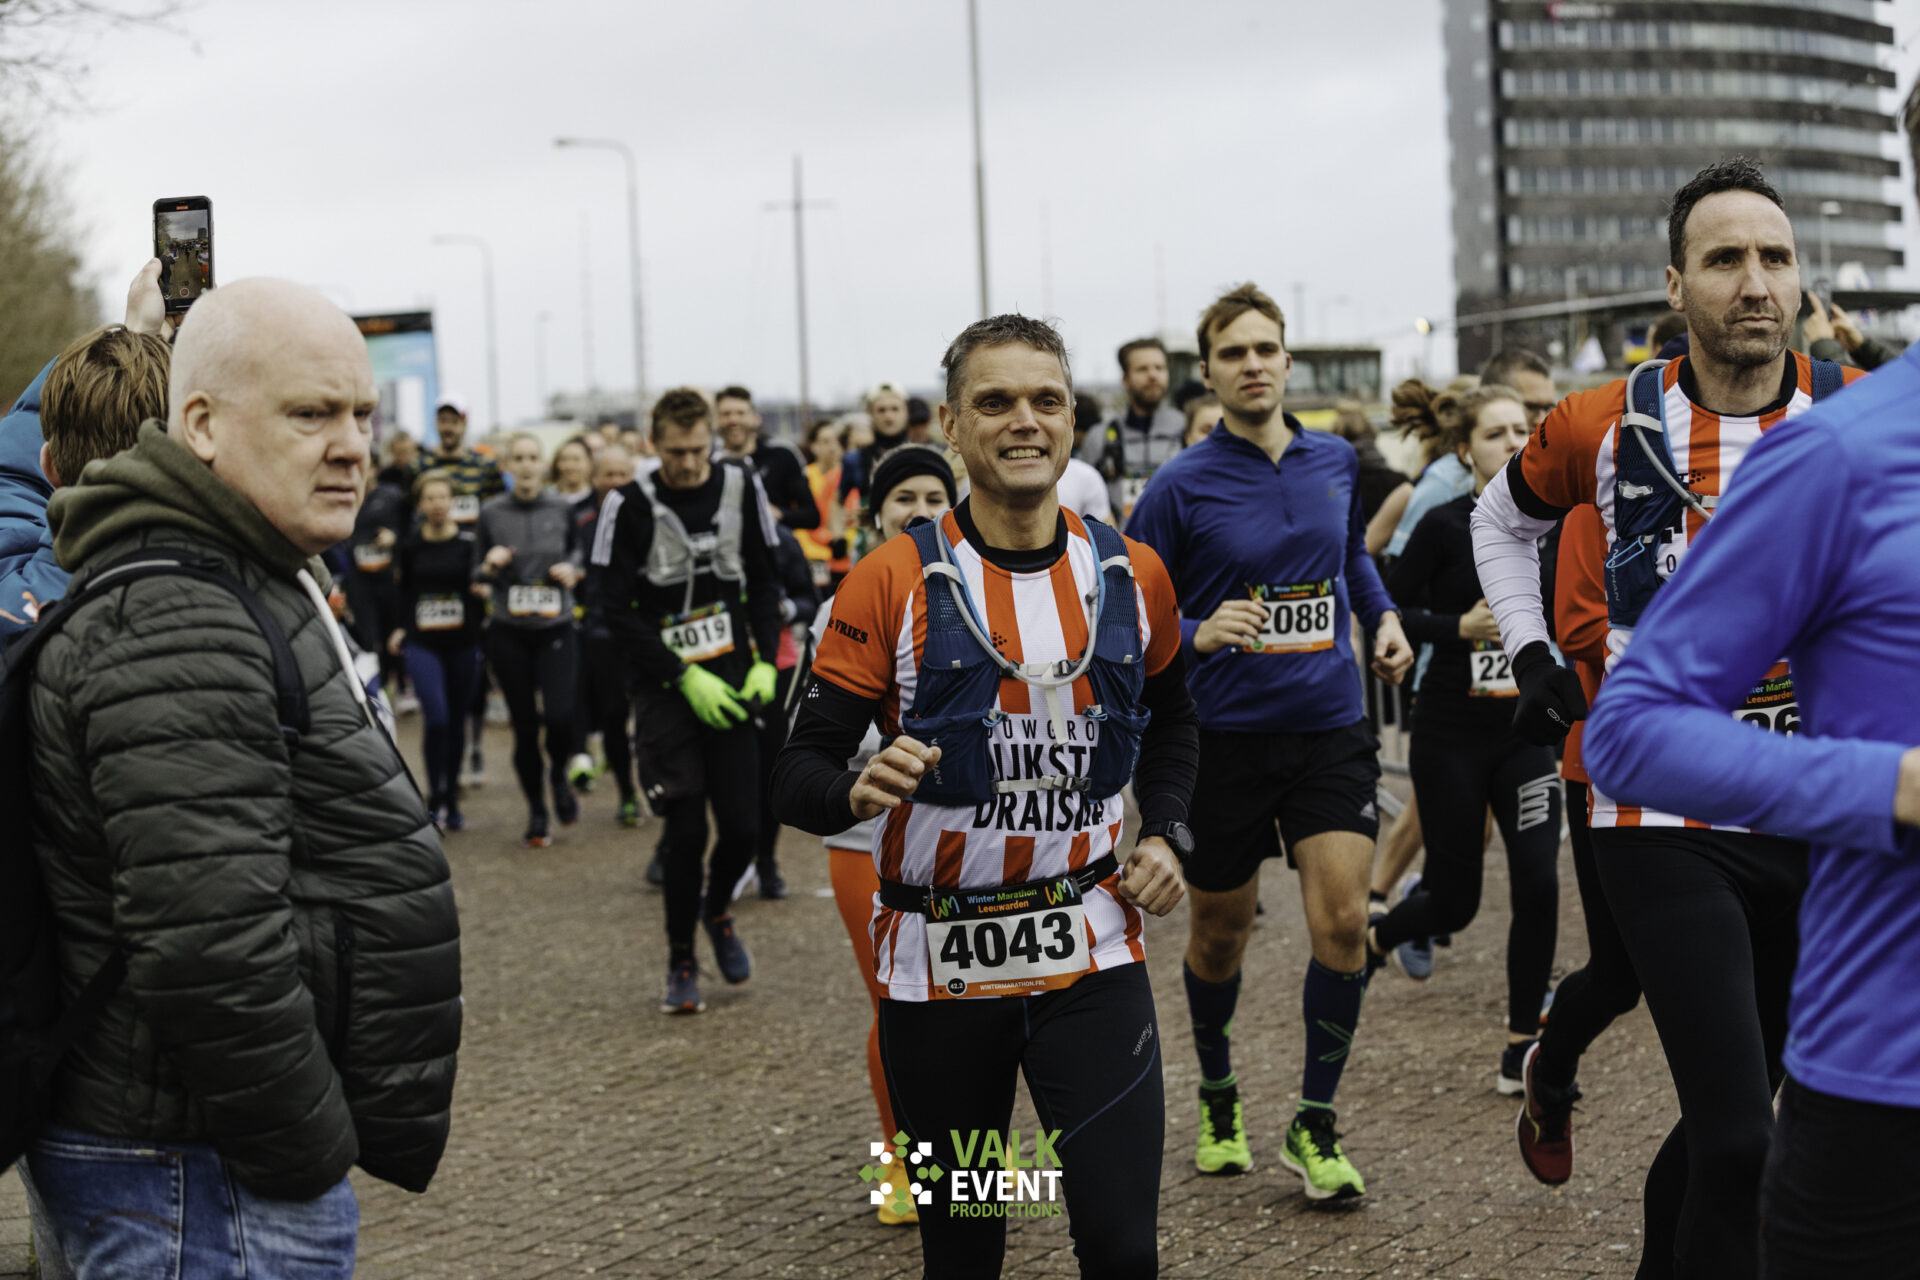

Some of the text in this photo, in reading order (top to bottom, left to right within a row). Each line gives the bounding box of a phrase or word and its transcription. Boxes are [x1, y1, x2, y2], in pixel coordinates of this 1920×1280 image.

[671, 618, 726, 648] 4019
[835, 618, 869, 645] VRIES
[1479, 654, 1510, 682] 22
[967, 888, 1037, 904] Winter Marathon
[977, 899, 1030, 914] Leeuwarden
[940, 911, 1075, 970] 4043
[980, 980, 1046, 991] WINTERMARATHON.FRL
